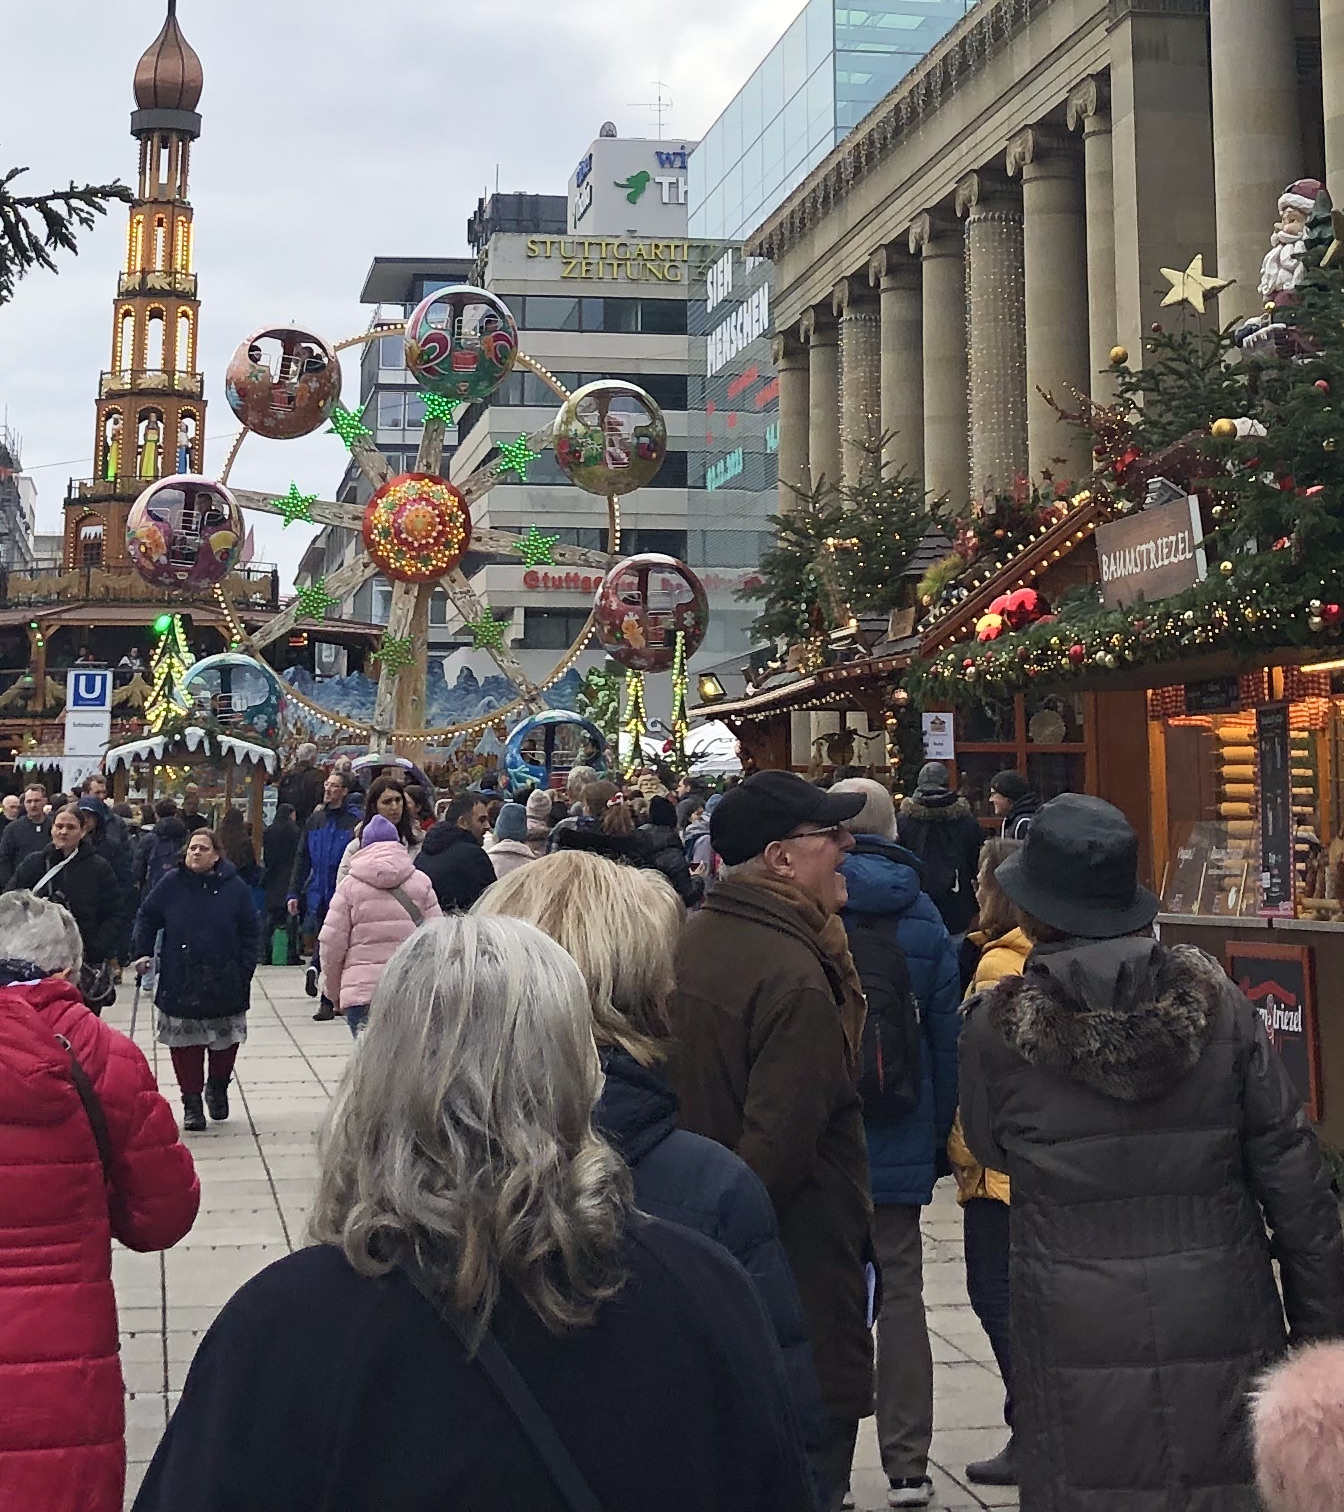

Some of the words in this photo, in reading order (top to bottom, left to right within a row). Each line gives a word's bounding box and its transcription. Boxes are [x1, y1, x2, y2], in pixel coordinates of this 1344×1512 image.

[560, 260, 682, 282] ZEITUNG
[706, 248, 733, 314] SIEH
[706, 281, 769, 379] MENSCHEN
[1101, 529, 1194, 582] BAUMSTRIEZEL
[78, 674, 102, 699] U
